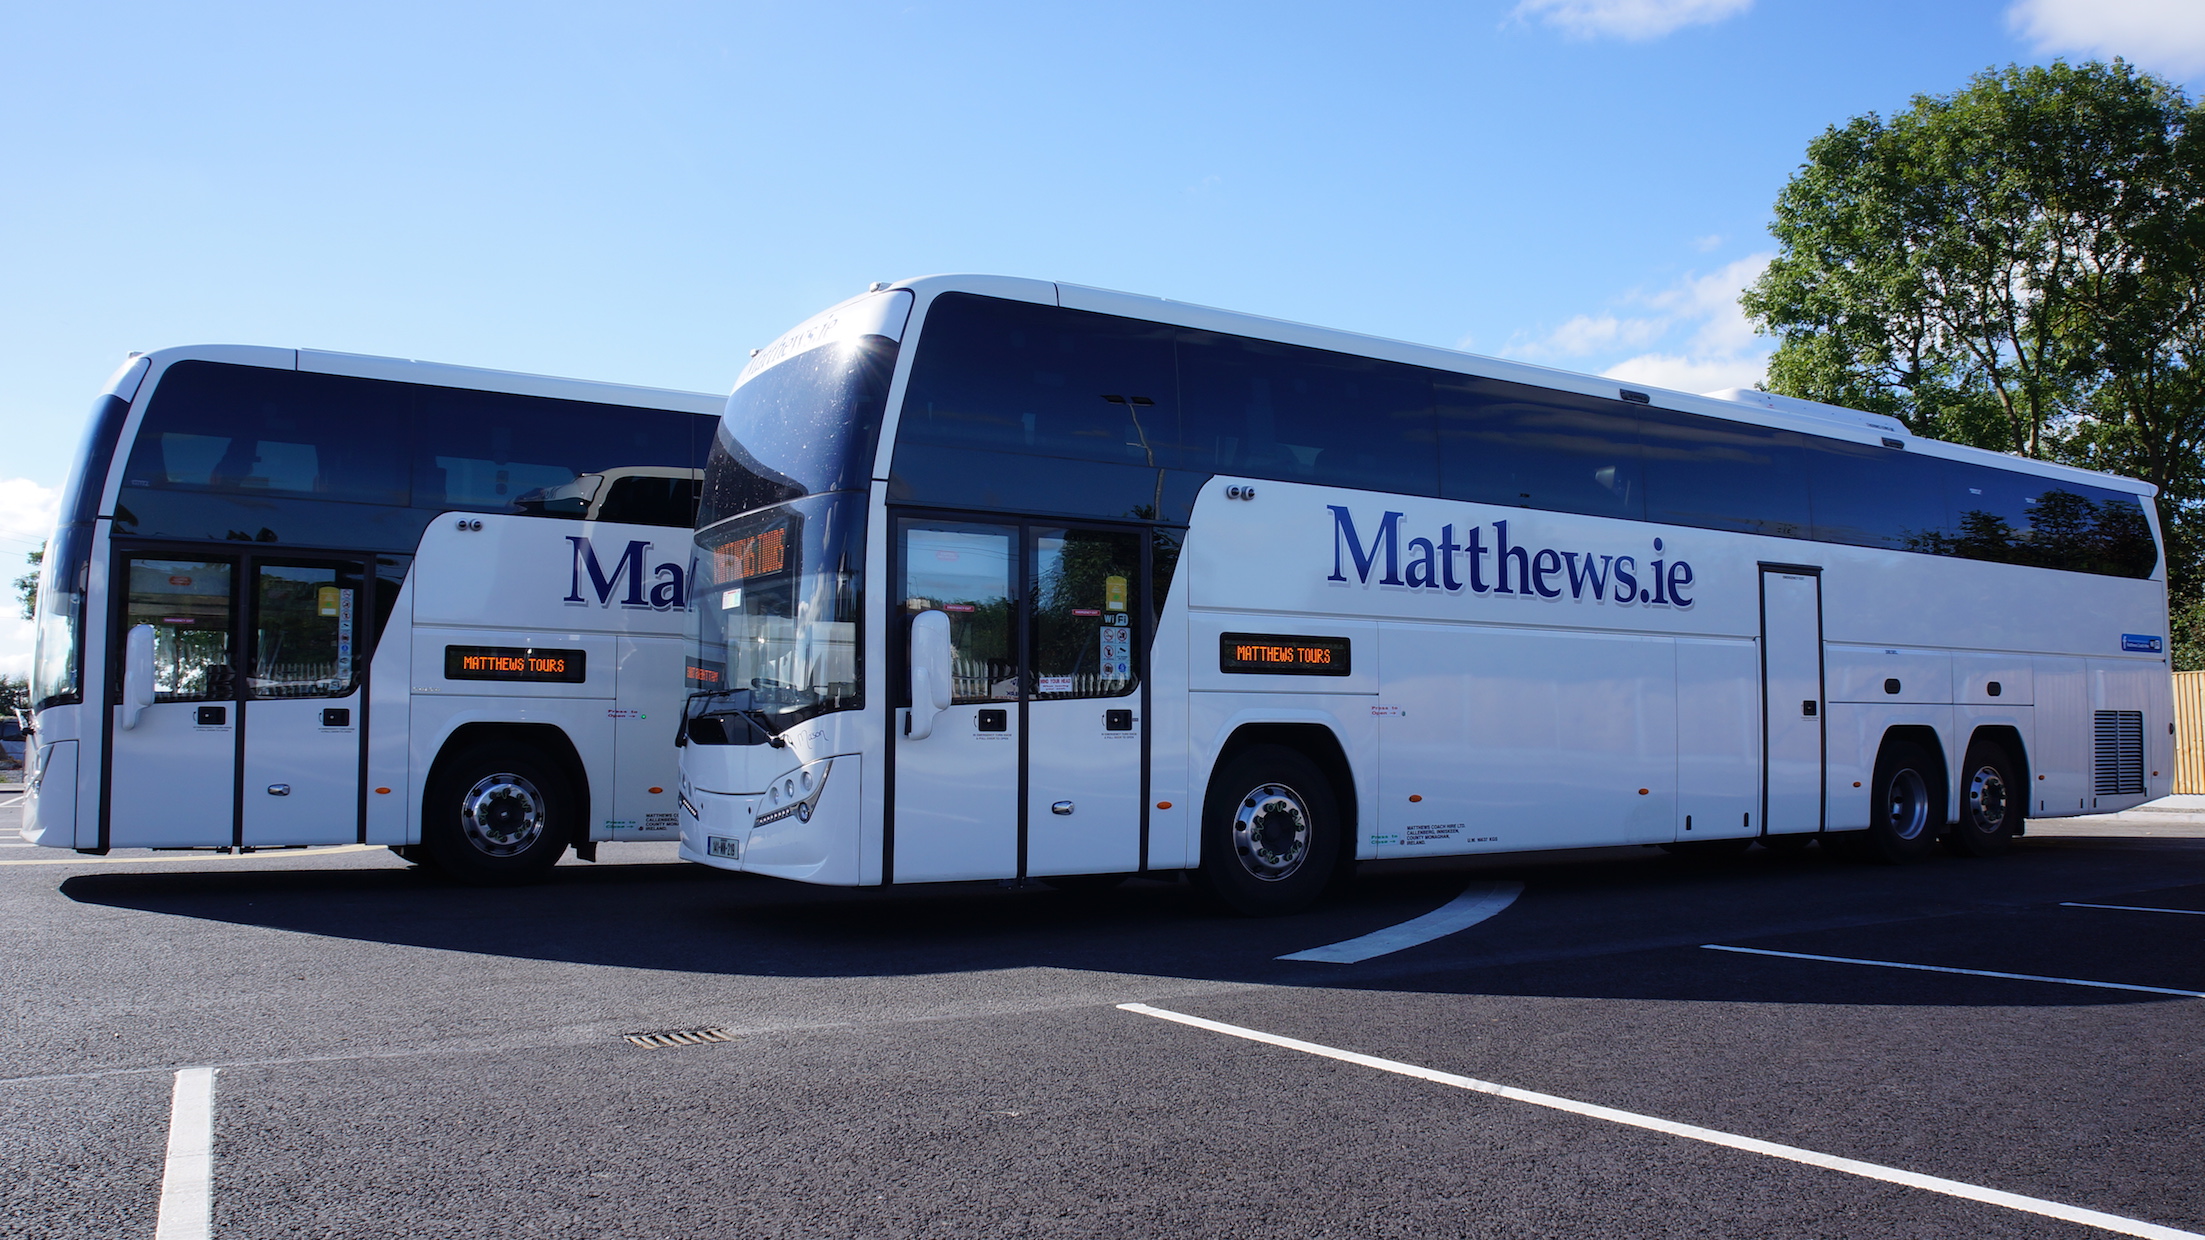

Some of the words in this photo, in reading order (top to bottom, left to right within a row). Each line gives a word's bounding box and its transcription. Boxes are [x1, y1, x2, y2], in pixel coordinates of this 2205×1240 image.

[563, 535, 688, 612] Ma
[1326, 504, 1695, 608] Matthews.ie
[463, 656, 524, 671] MATTHEWS
[528, 658, 565, 672] TOURS
[1235, 645, 1294, 662] MATTHEWS
[1297, 647, 1331, 664] TOURS
